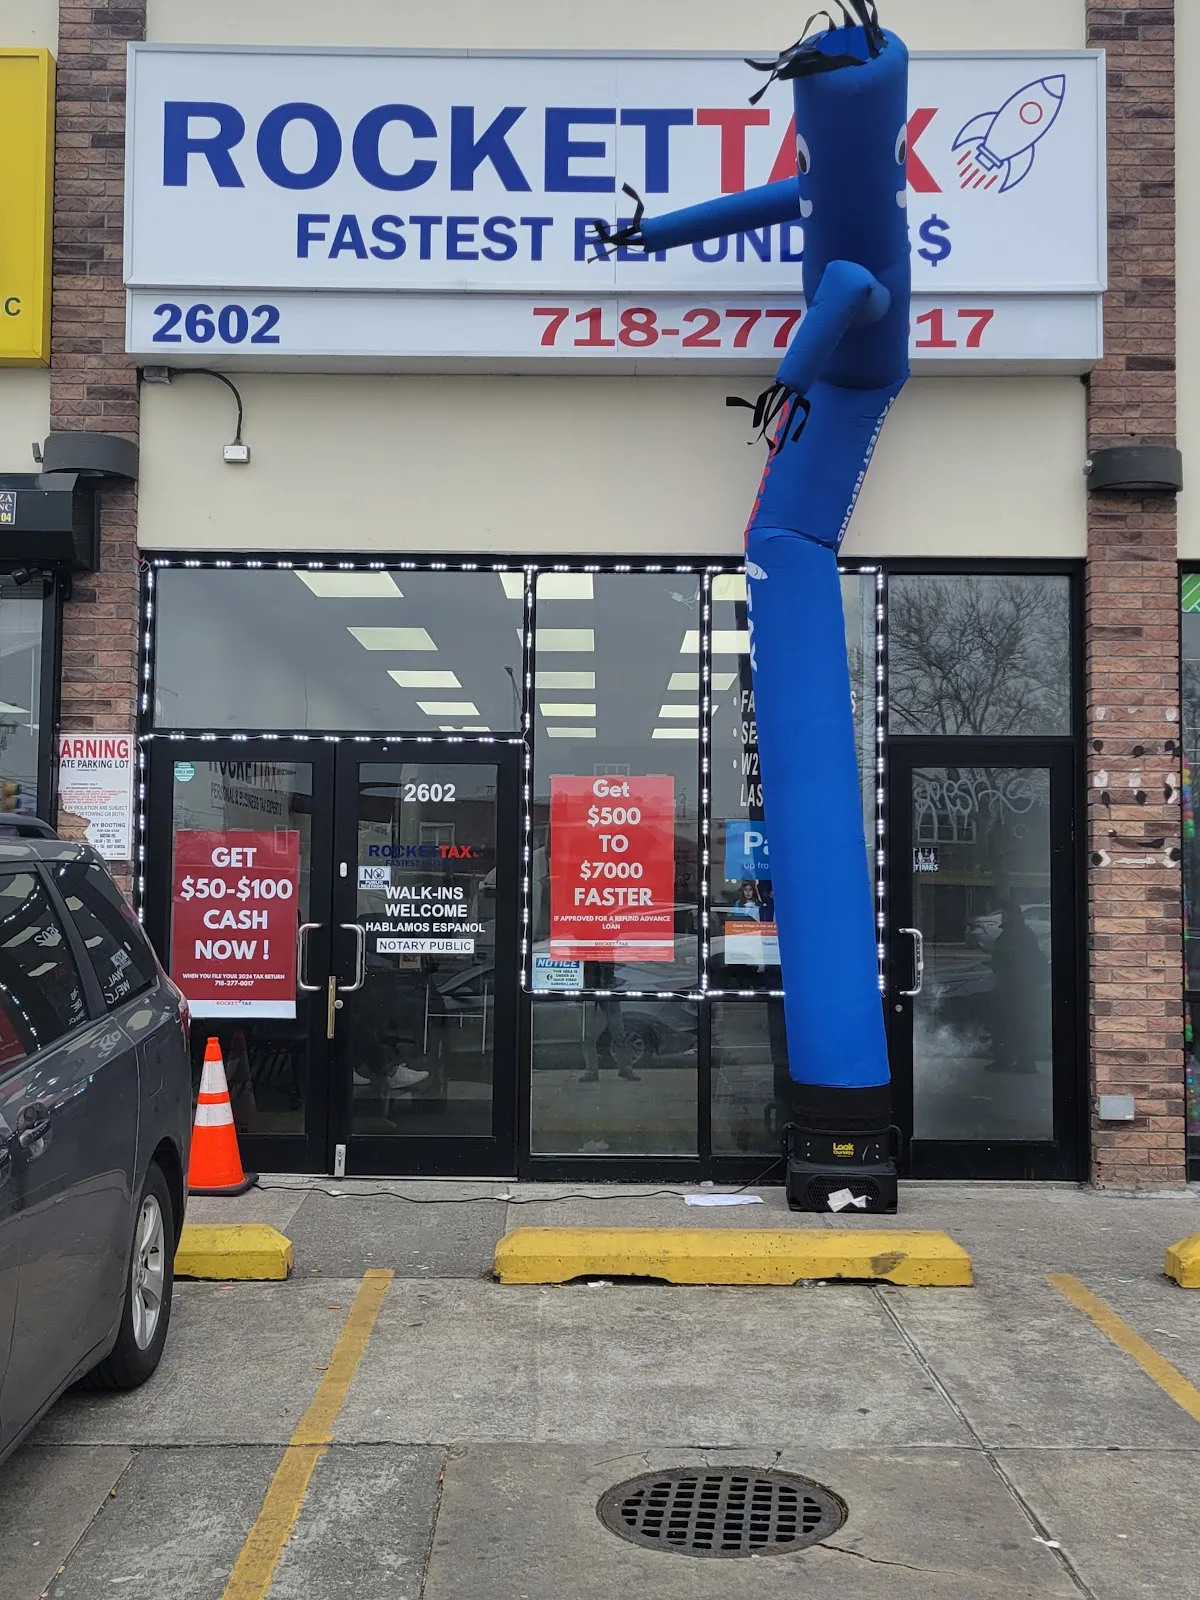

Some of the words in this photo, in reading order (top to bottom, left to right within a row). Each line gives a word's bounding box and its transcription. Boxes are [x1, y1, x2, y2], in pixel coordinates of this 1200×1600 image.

[297, 213, 554, 261] FASTEST
[152, 303, 280, 344] 2602
[78, 759, 113, 769] PARKING
[115, 759, 129, 769] LOT
[741, 752, 759, 775] W2
[403, 783, 456, 802] 2602
[592, 779, 630, 798] Get
[586, 805, 641, 828] $500
[598, 834, 629, 853] TO
[211, 847, 257, 868] GET
[385, 859, 420, 867] FASTEST
[743, 863, 755, 871] up
[579, 861, 643, 881] $7000
[180, 875, 293, 901] $50-$100
[385, 886, 464, 900] WALK-INS
[574, 887, 654, 906] FASTER
[203, 910, 268, 930] CASH
[385, 903, 468, 918] WELCOME
[365, 922, 430, 932] HABLAMOS
[432, 922, 486, 933] ESPANOL
[195, 940, 257, 960] NOW
[380, 941, 426, 950] NOTARY
[430, 941, 472, 951] PUBLIC
[537, 958, 578, 968] NOTICE
[832, 1142, 855, 1151] Look
